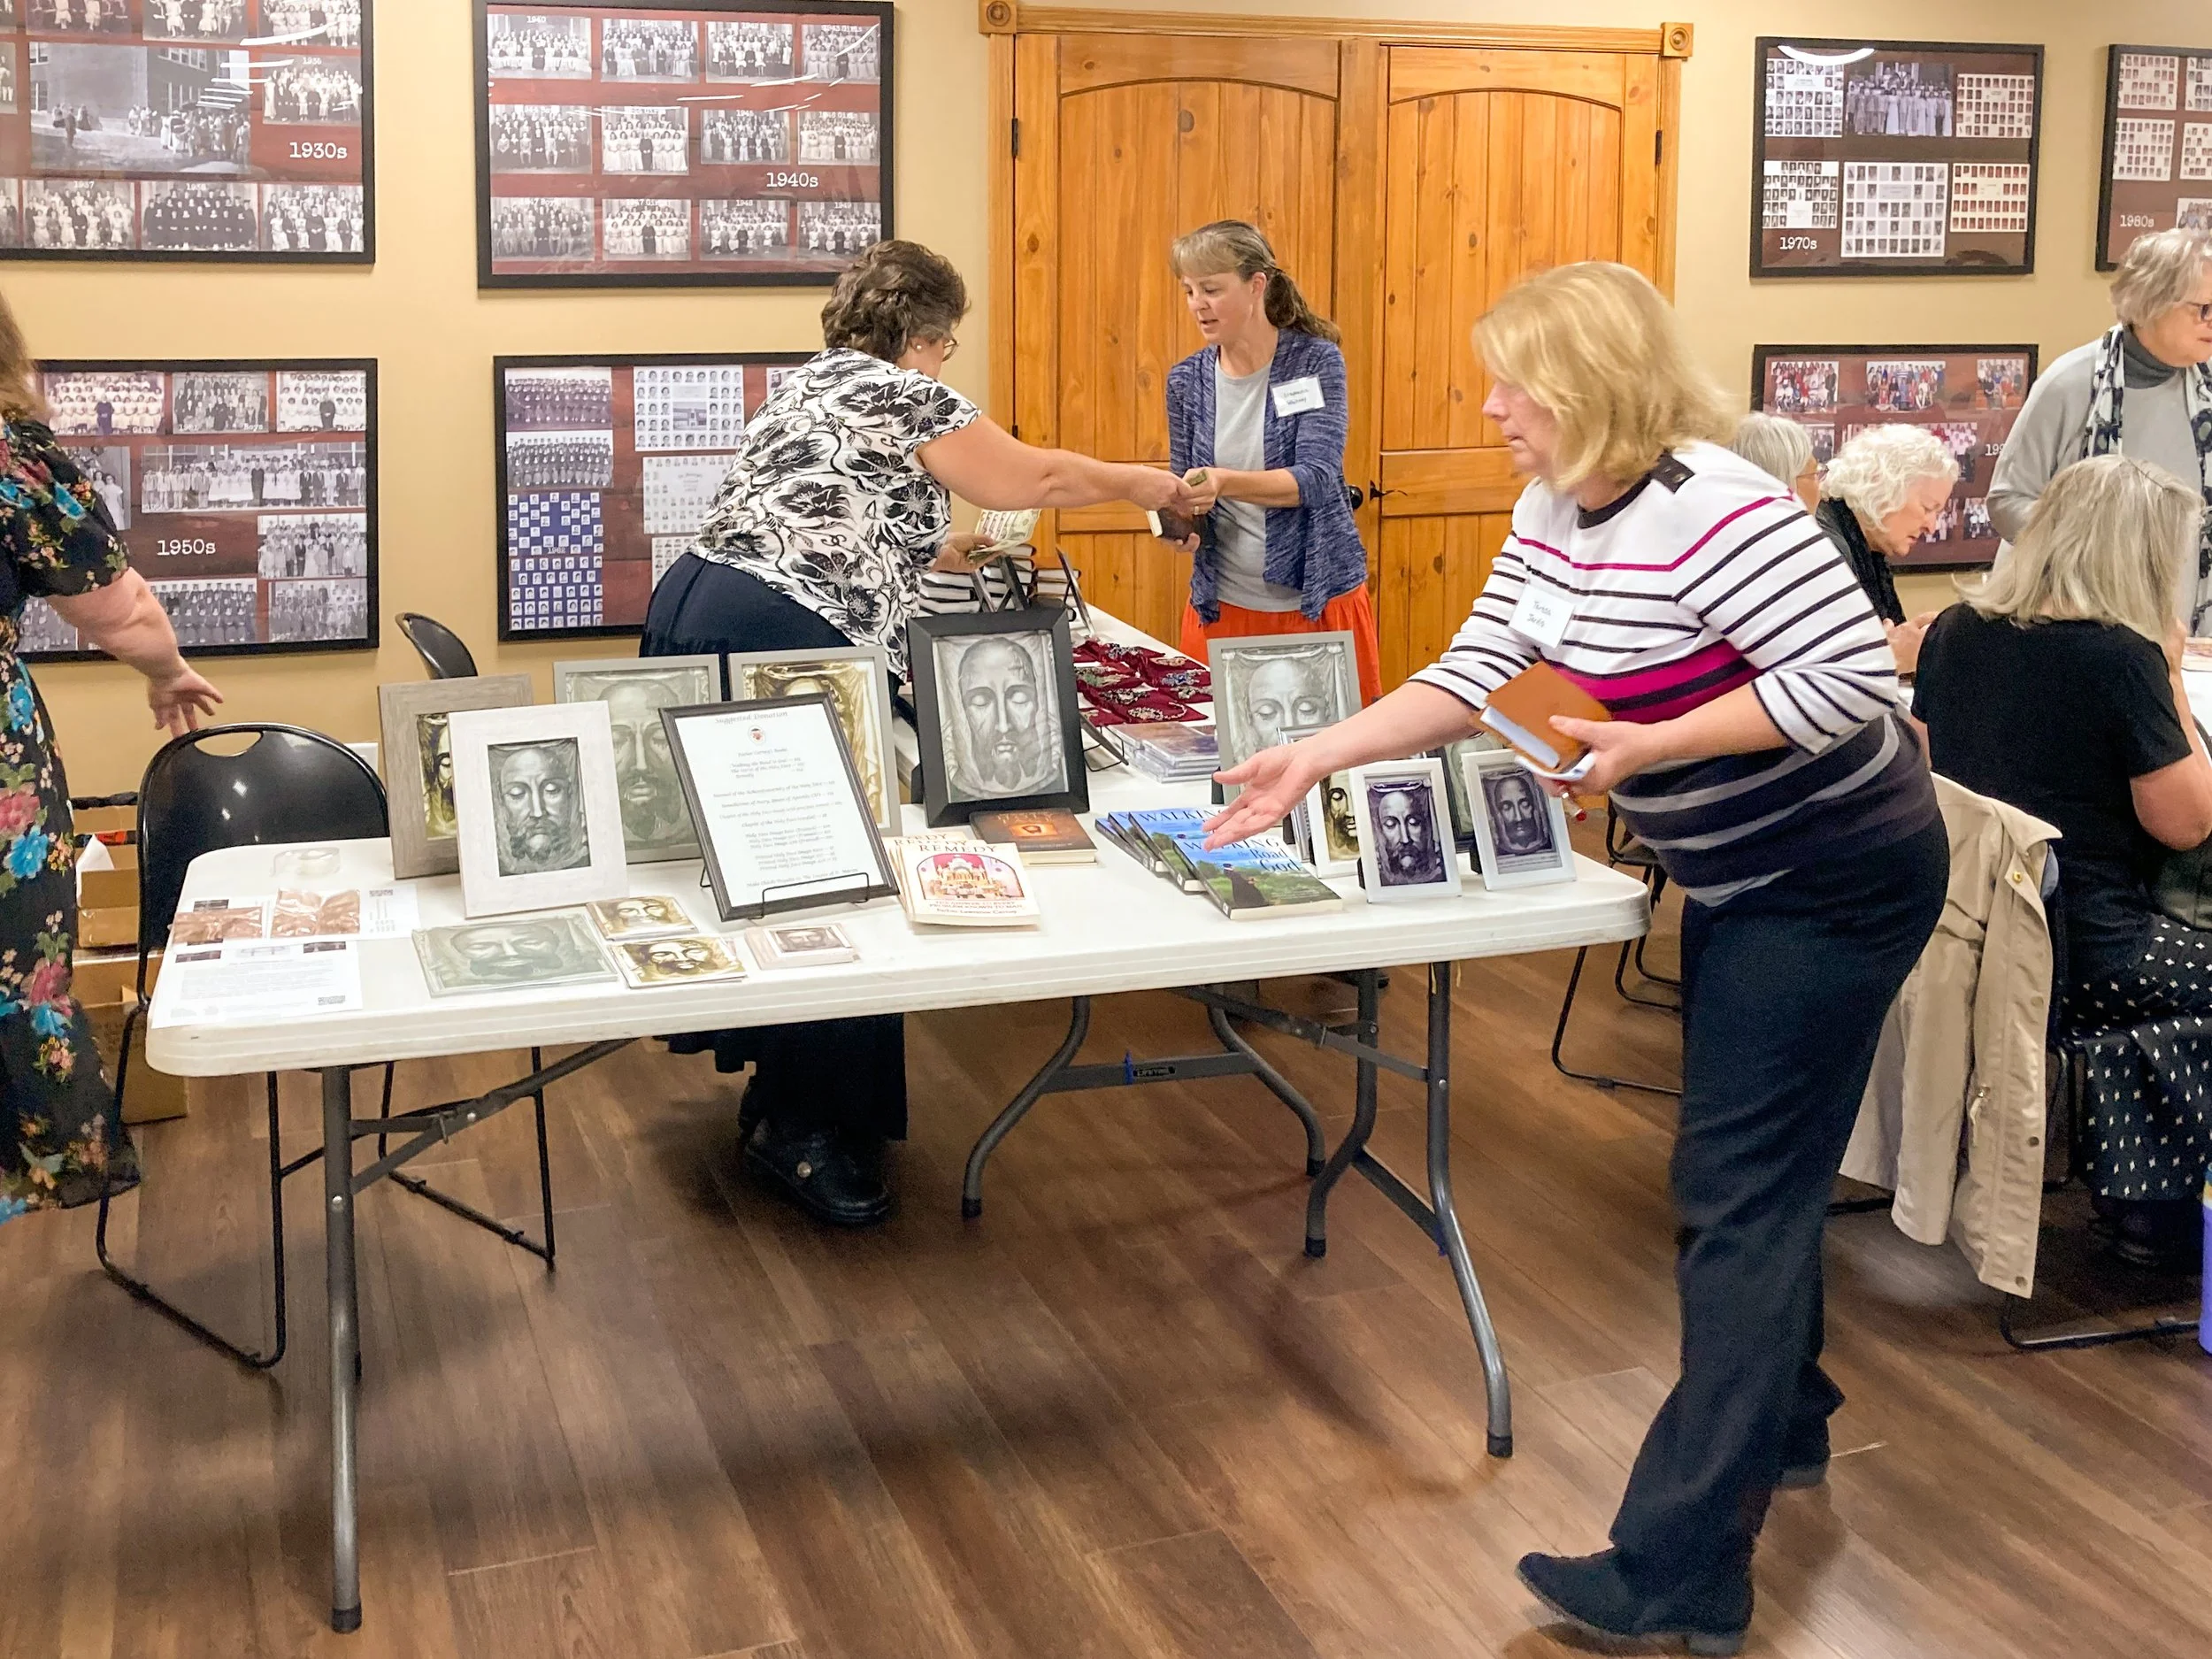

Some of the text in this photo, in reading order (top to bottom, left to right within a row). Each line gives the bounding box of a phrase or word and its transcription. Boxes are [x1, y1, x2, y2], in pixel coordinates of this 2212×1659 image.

[289, 142, 348, 159] 1930s
[766, 172, 818, 188] 1940s
[2120, 215, 2154, 227] 1980s
[1779, 236, 1817, 250] 1970s
[157, 539, 216, 556] 1950s
[1139, 810, 1223, 822] WALKIN
[919, 844, 997, 853] REMEDY
[1248, 849, 1289, 860] Road
[1259, 859, 1302, 872] God
